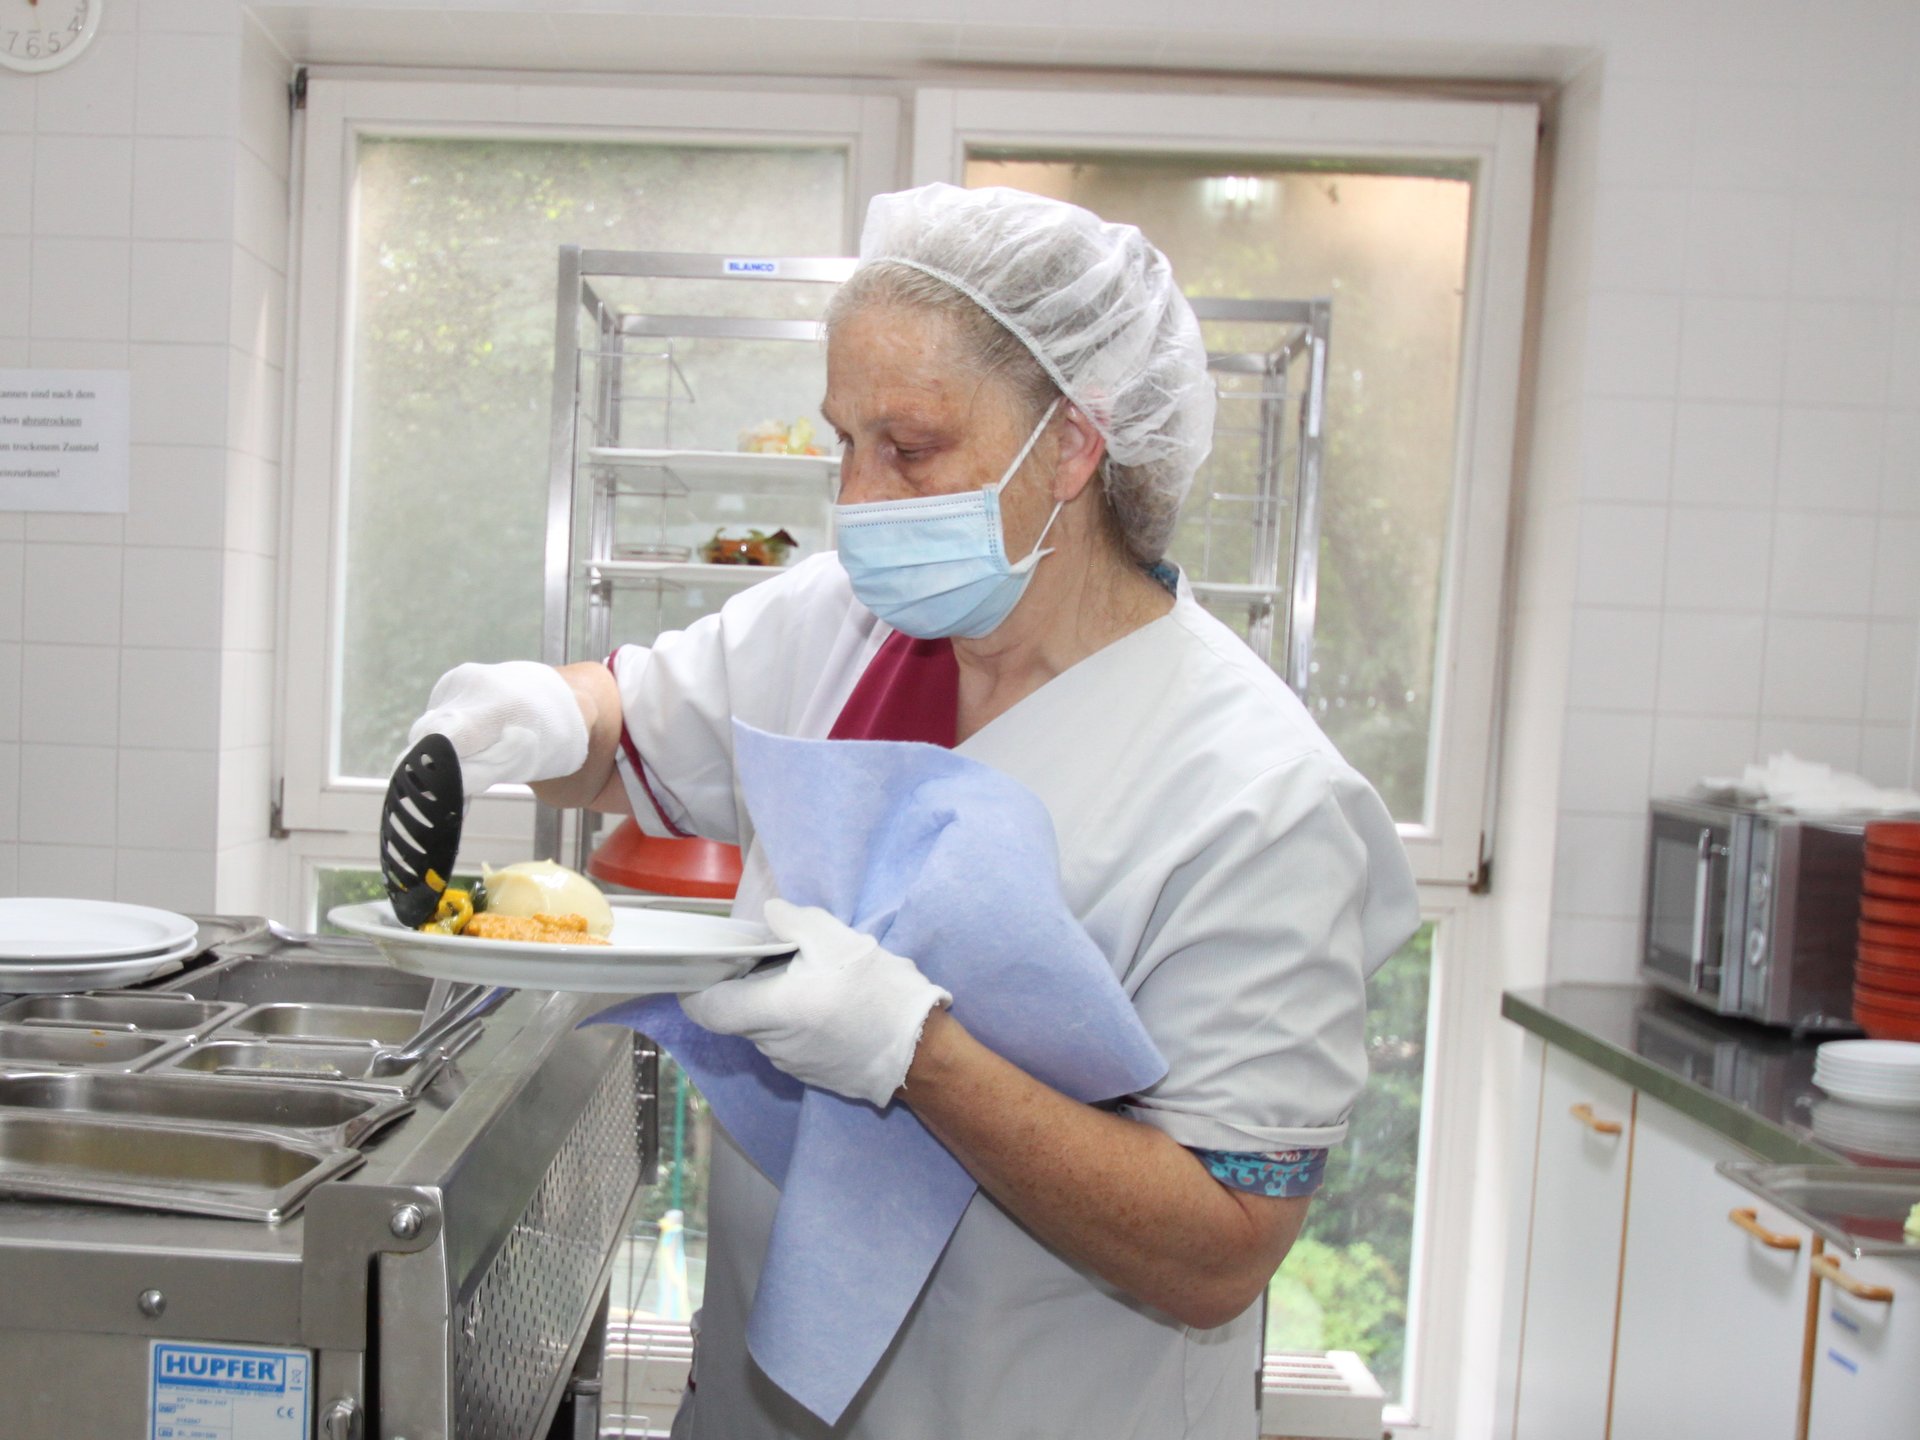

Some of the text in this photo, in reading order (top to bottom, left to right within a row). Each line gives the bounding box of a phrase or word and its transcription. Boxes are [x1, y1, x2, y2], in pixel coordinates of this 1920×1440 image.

[67, 15, 82, 37] 4
[7, 31, 19, 52] 7
[26, 35, 41, 58] 6
[48, 31, 61, 53] 5
[729, 262, 775, 272] BLANCO
[31, 389, 50, 399] sind
[52, 389, 73, 399] nach
[76, 389, 96, 399] dem
[22, 416, 82, 427] abzutrocknen
[63, 442, 99, 452] Zustand
[166, 1354, 276, 1381] HUPFER
